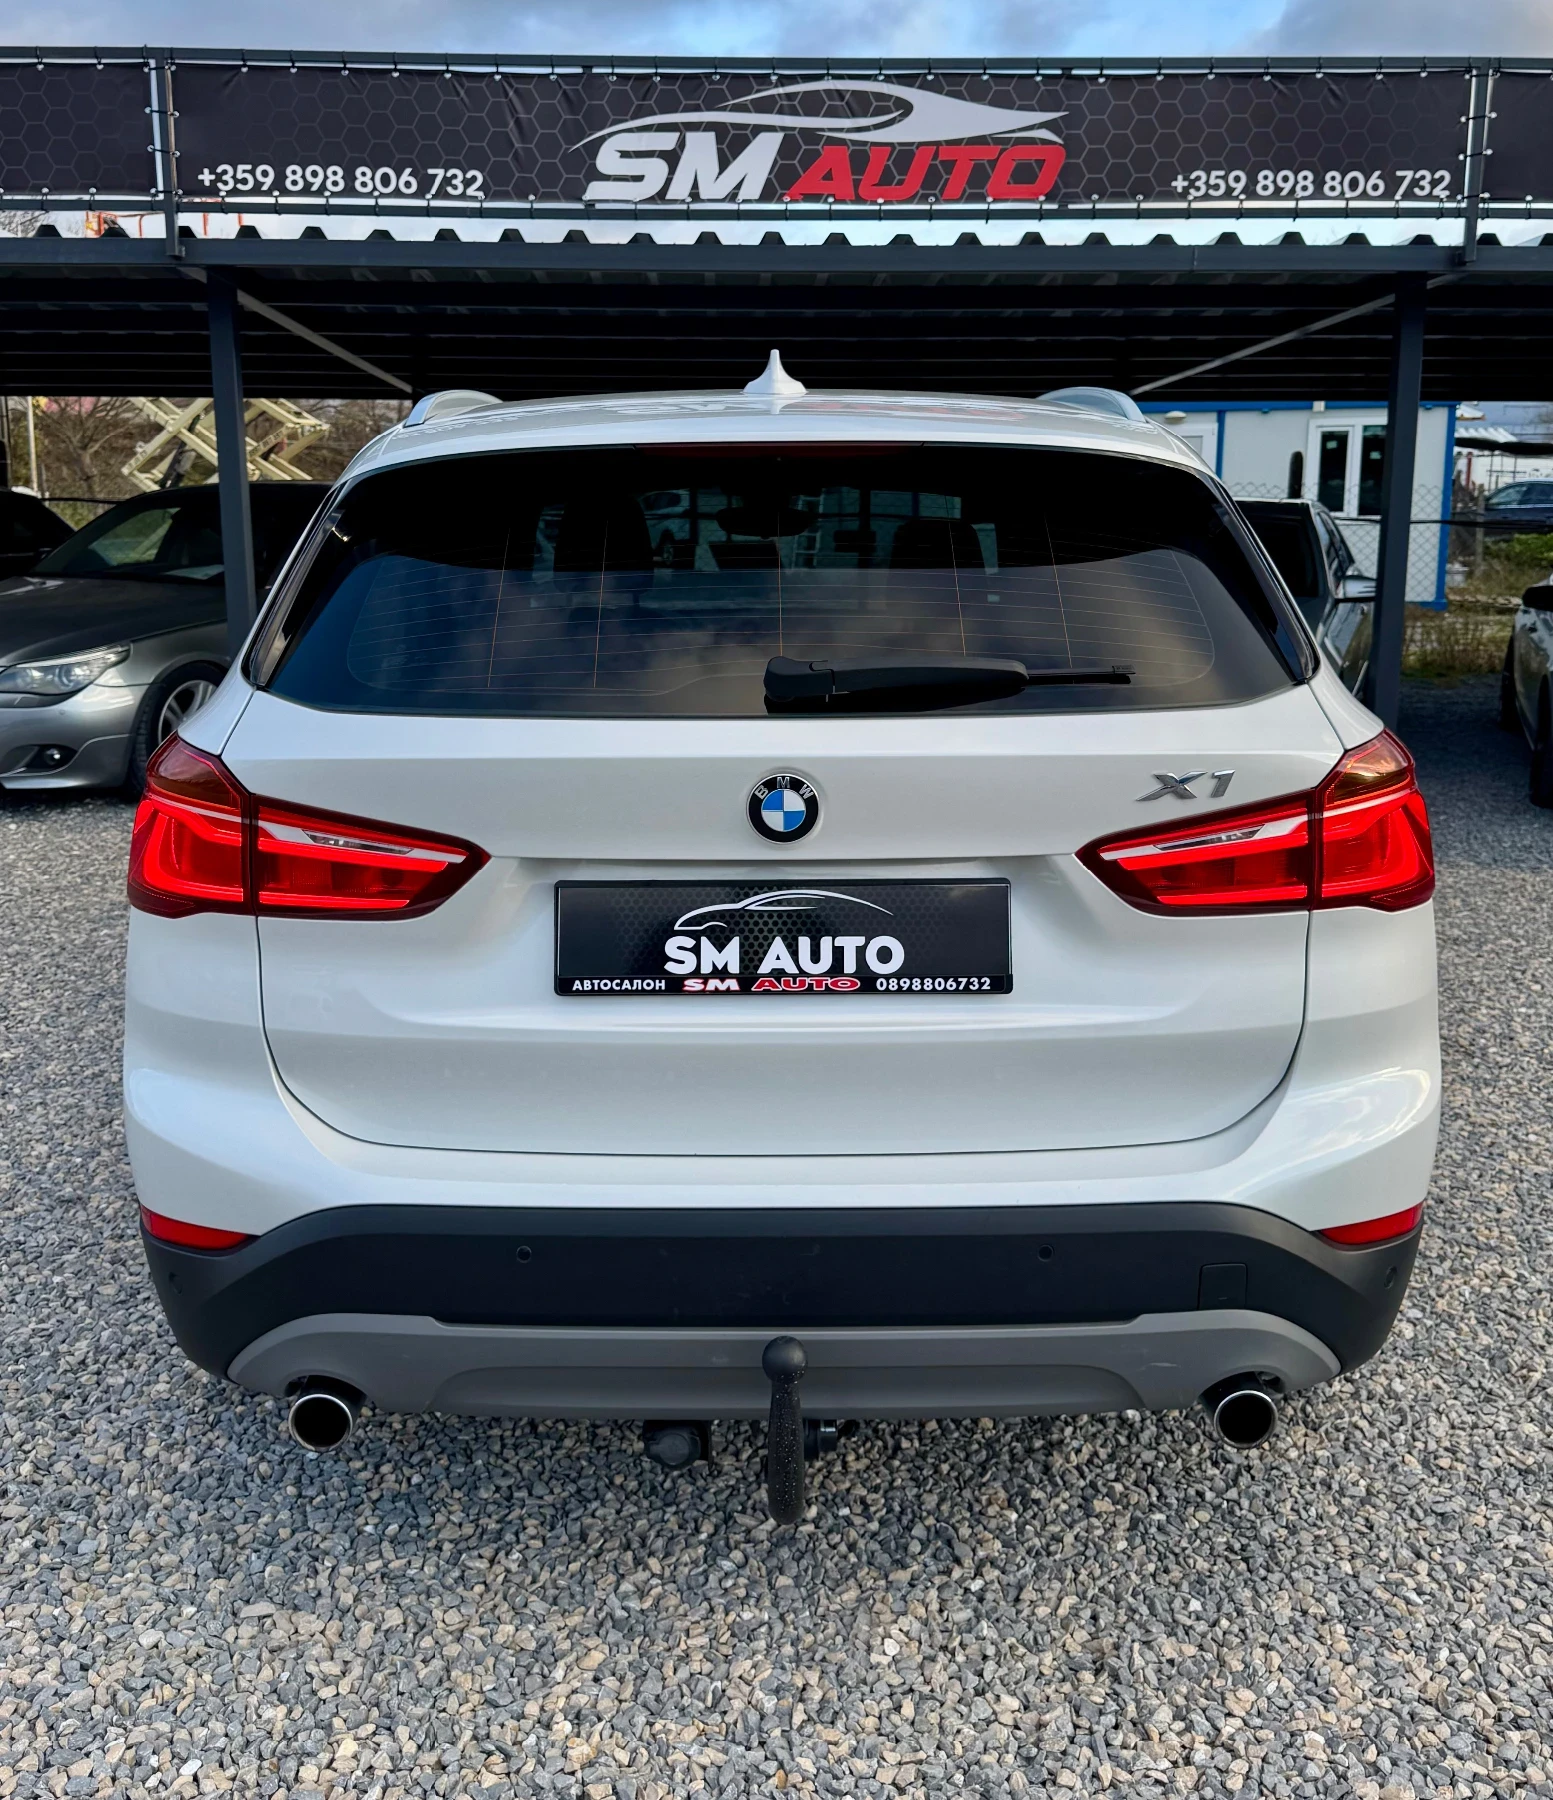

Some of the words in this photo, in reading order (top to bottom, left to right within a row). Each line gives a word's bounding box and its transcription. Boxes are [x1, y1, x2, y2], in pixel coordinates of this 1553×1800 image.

[197, 163, 275, 192] +359
[284, 164, 345, 193] 898
[354, 166, 418, 195] 806
[424, 168, 485, 197] 732
[586, 132, 784, 202] SM
[785, 145, 1066, 201] AUTO
[1170, 170, 1247, 197] +359
[1255, 169, 1315, 197] 898
[1323, 170, 1385, 197] 806
[1394, 170, 1451, 197] 732
[753, 776, 814, 800] BMW
[1135, 769, 1236, 801] X1
[663, 935, 740, 974] SM
[756, 935, 905, 975] AUTO
[572, 979, 666, 991] АВТОСАЛОН
[682, 977, 741, 992] SM
[751, 976, 861, 992] AUTO
[876, 976, 991, 991] 0898806732
